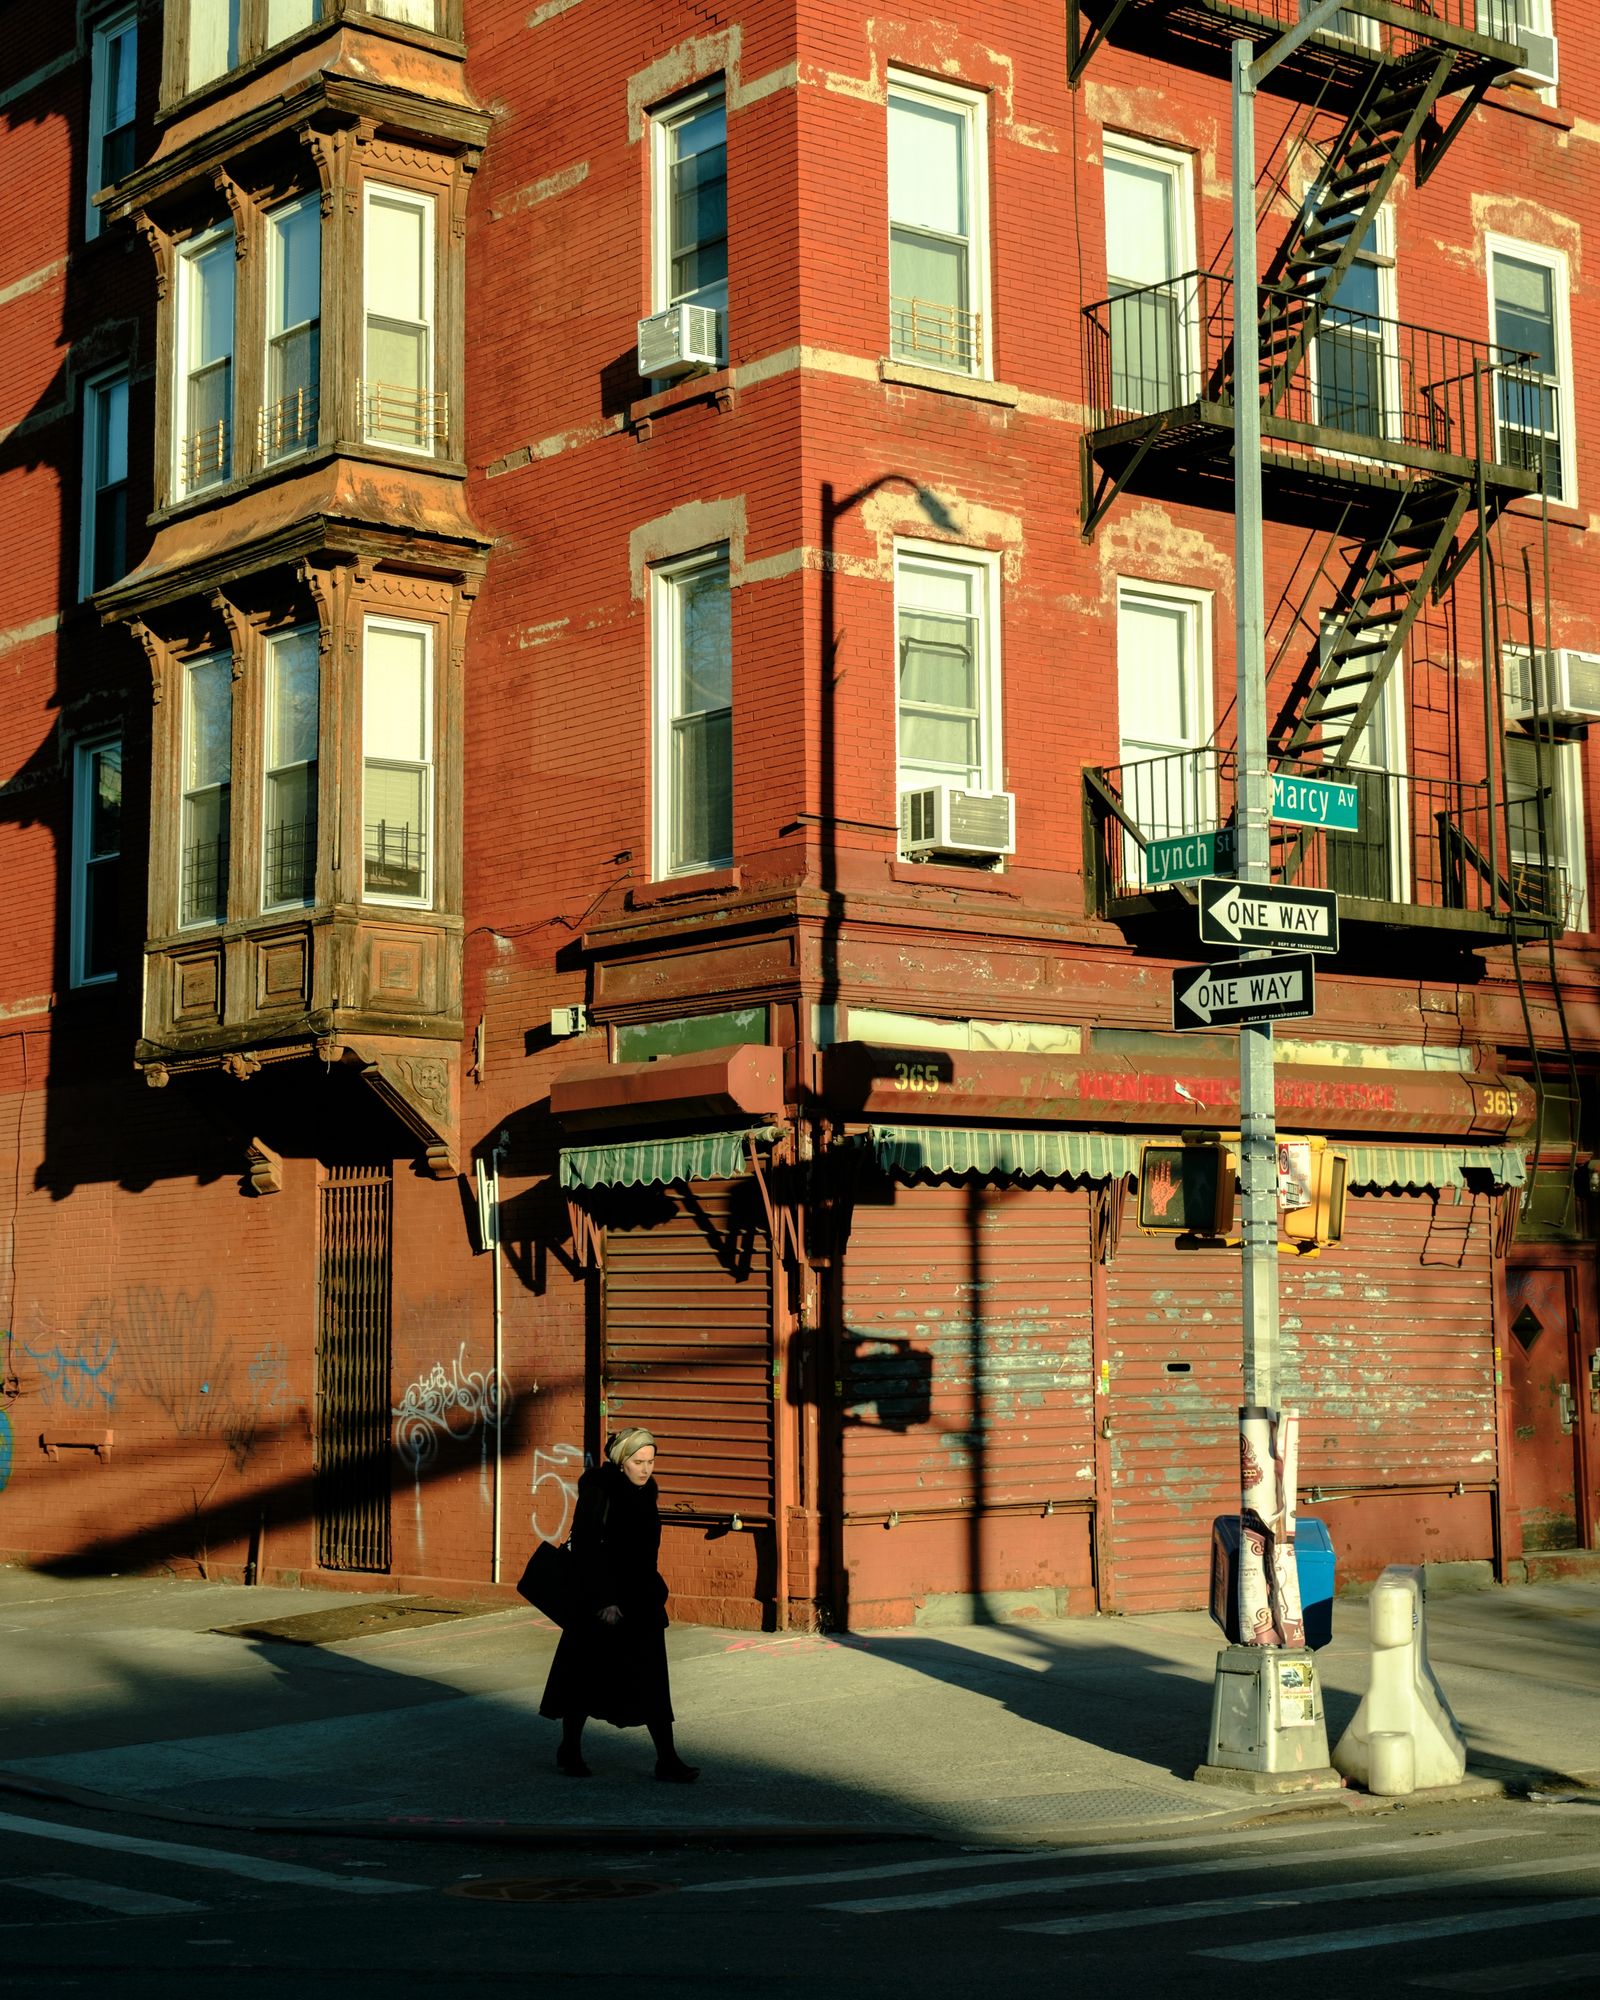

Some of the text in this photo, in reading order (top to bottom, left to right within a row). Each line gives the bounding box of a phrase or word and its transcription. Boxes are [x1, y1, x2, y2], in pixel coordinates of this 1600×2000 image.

[1272, 779, 1354, 821] Marcy Av
[1152, 834, 1230, 880] Lynch St
[1227, 901, 1319, 931] ONE WAY
[1297, 943, 1334, 951] TRANSPORTATION
[1198, 975, 1293, 1008] ONE WAY
[1268, 1010, 1309, 1019] TRANSPORTATION
[894, 1063, 939, 1092] 365
[1483, 1090, 1518, 1116] 365
